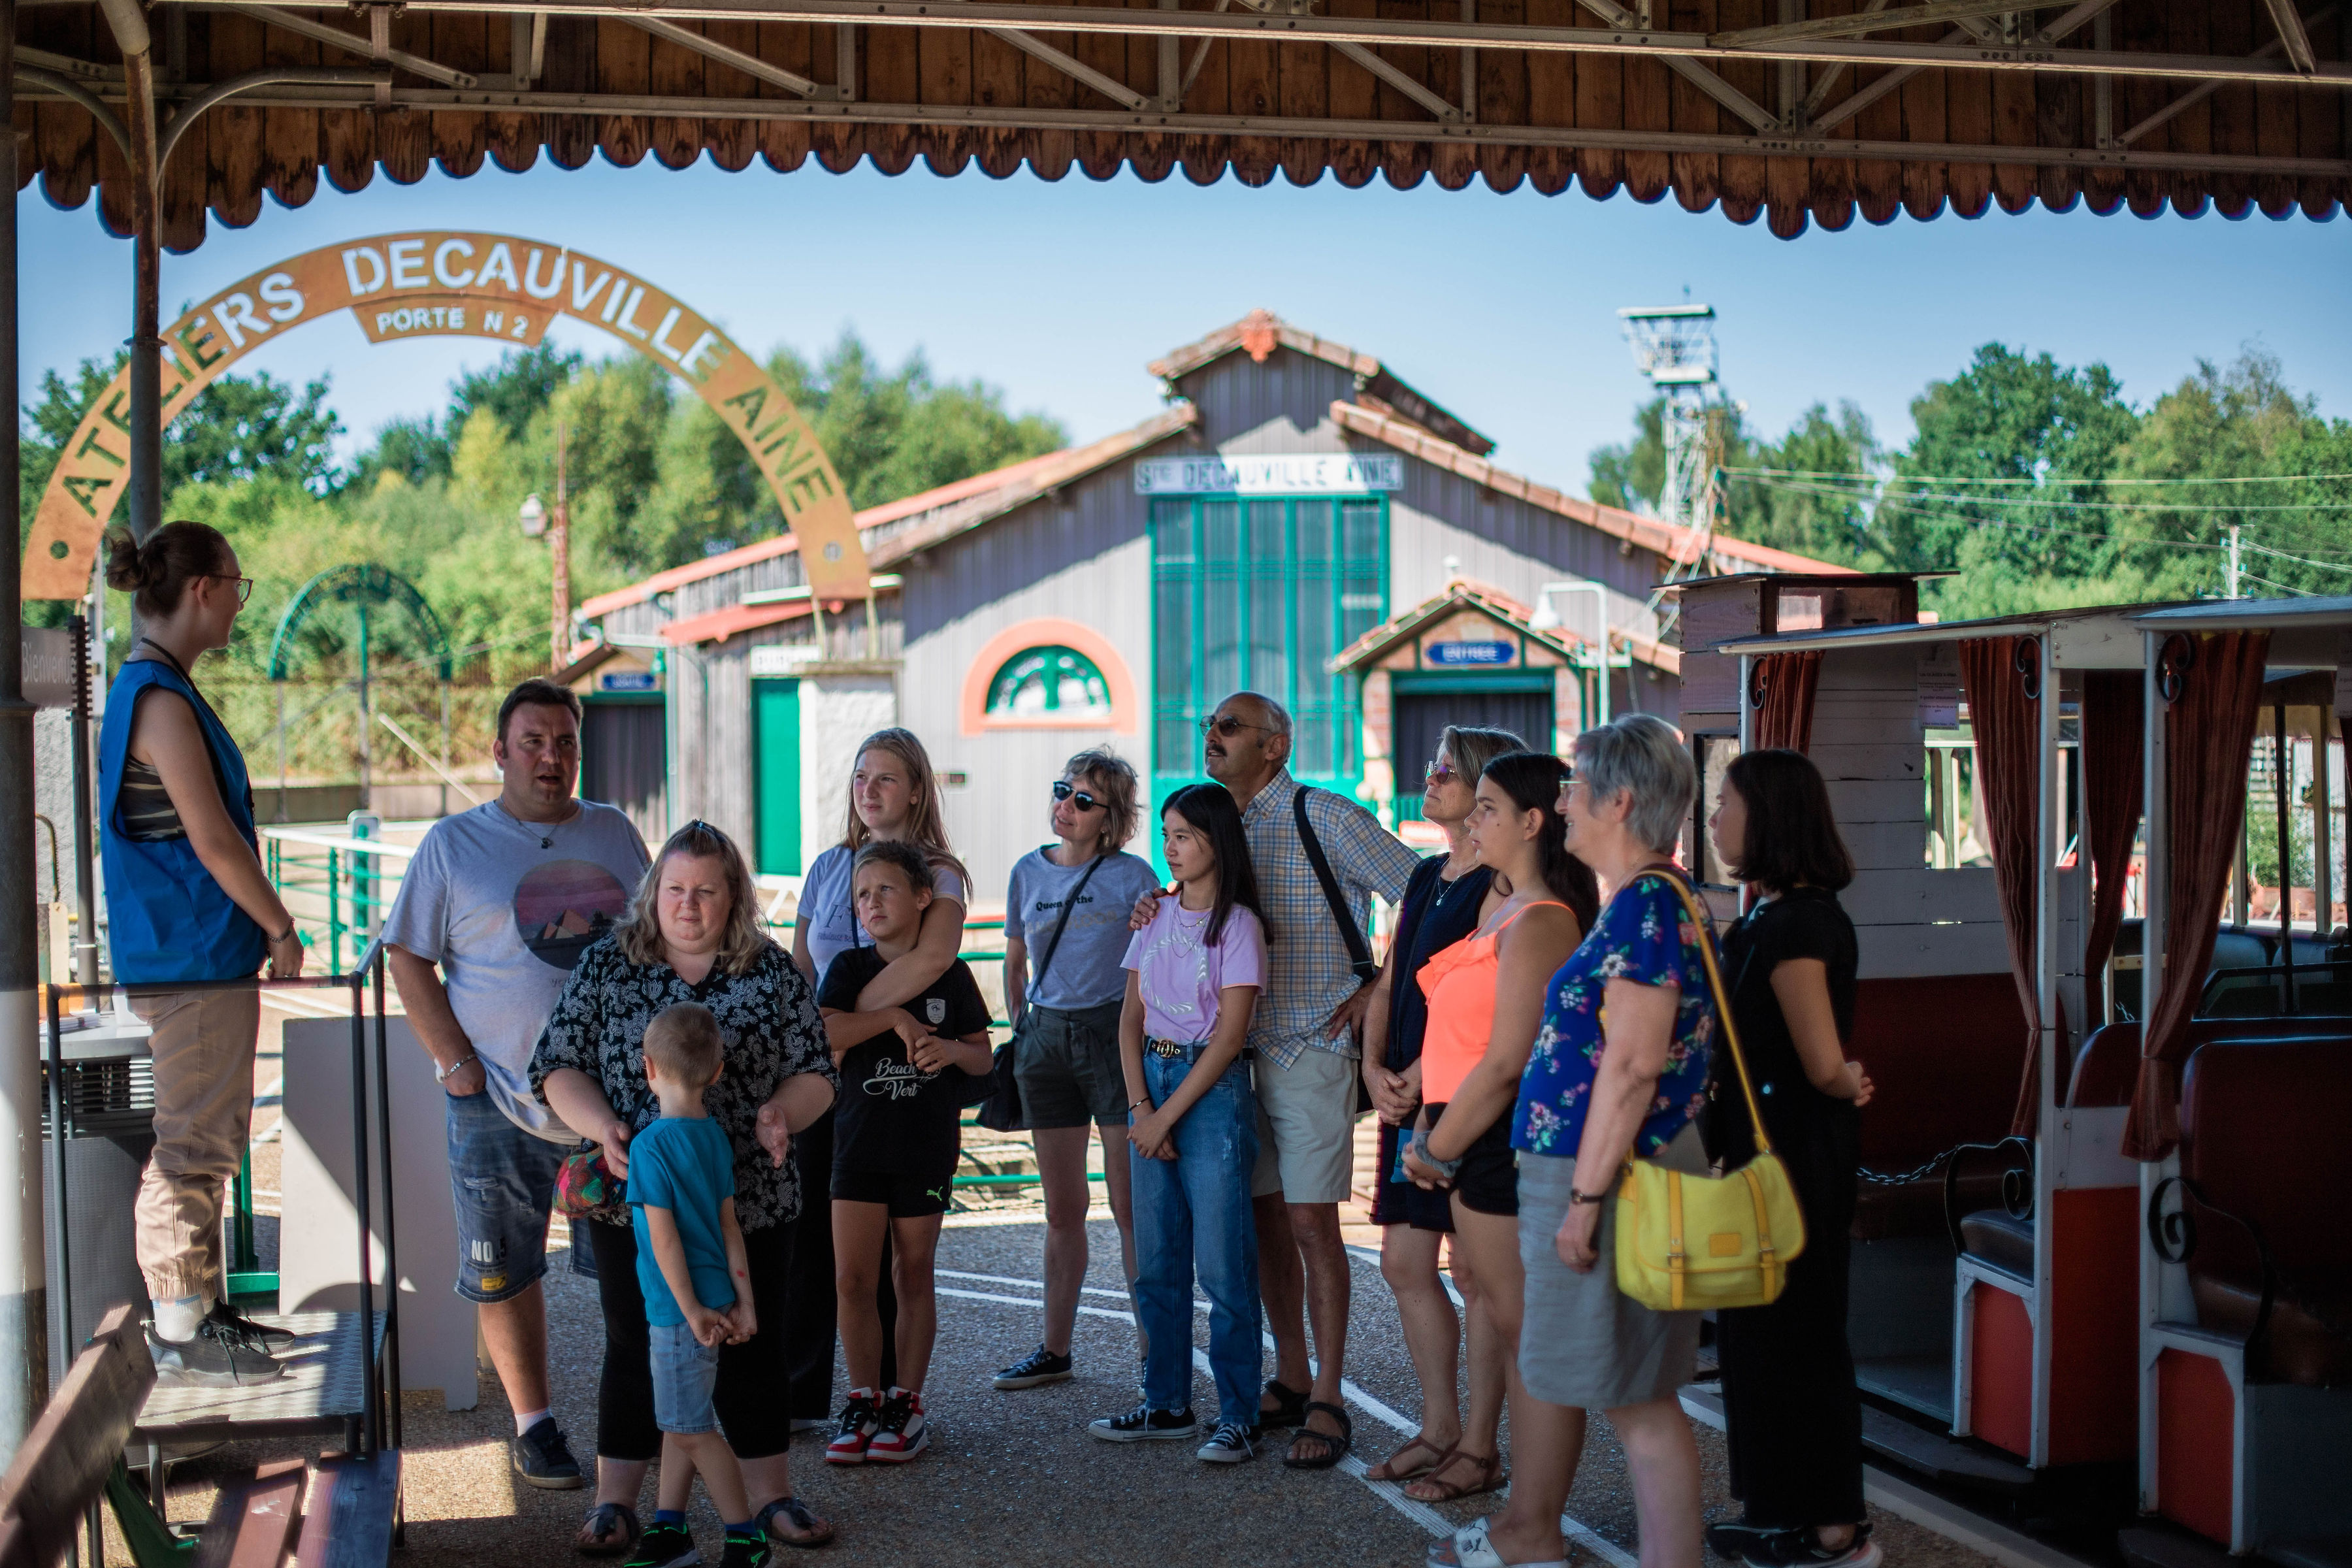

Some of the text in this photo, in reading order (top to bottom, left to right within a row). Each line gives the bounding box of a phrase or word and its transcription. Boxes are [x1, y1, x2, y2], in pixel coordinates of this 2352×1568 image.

[376, 306, 529, 338] PORTE N 2
[341, 238, 731, 384] DECAUVILLE
[723, 386, 834, 514] AINE
[1183, 459, 1327, 489] DECAUVILLE
[22, 641, 77, 685] Bienvenue
[1036, 900, 1063, 911] Queen
[1076, 894, 1094, 904] the
[875, 1057, 917, 1078] Beach
[885, 1080, 922, 1100] Vert
